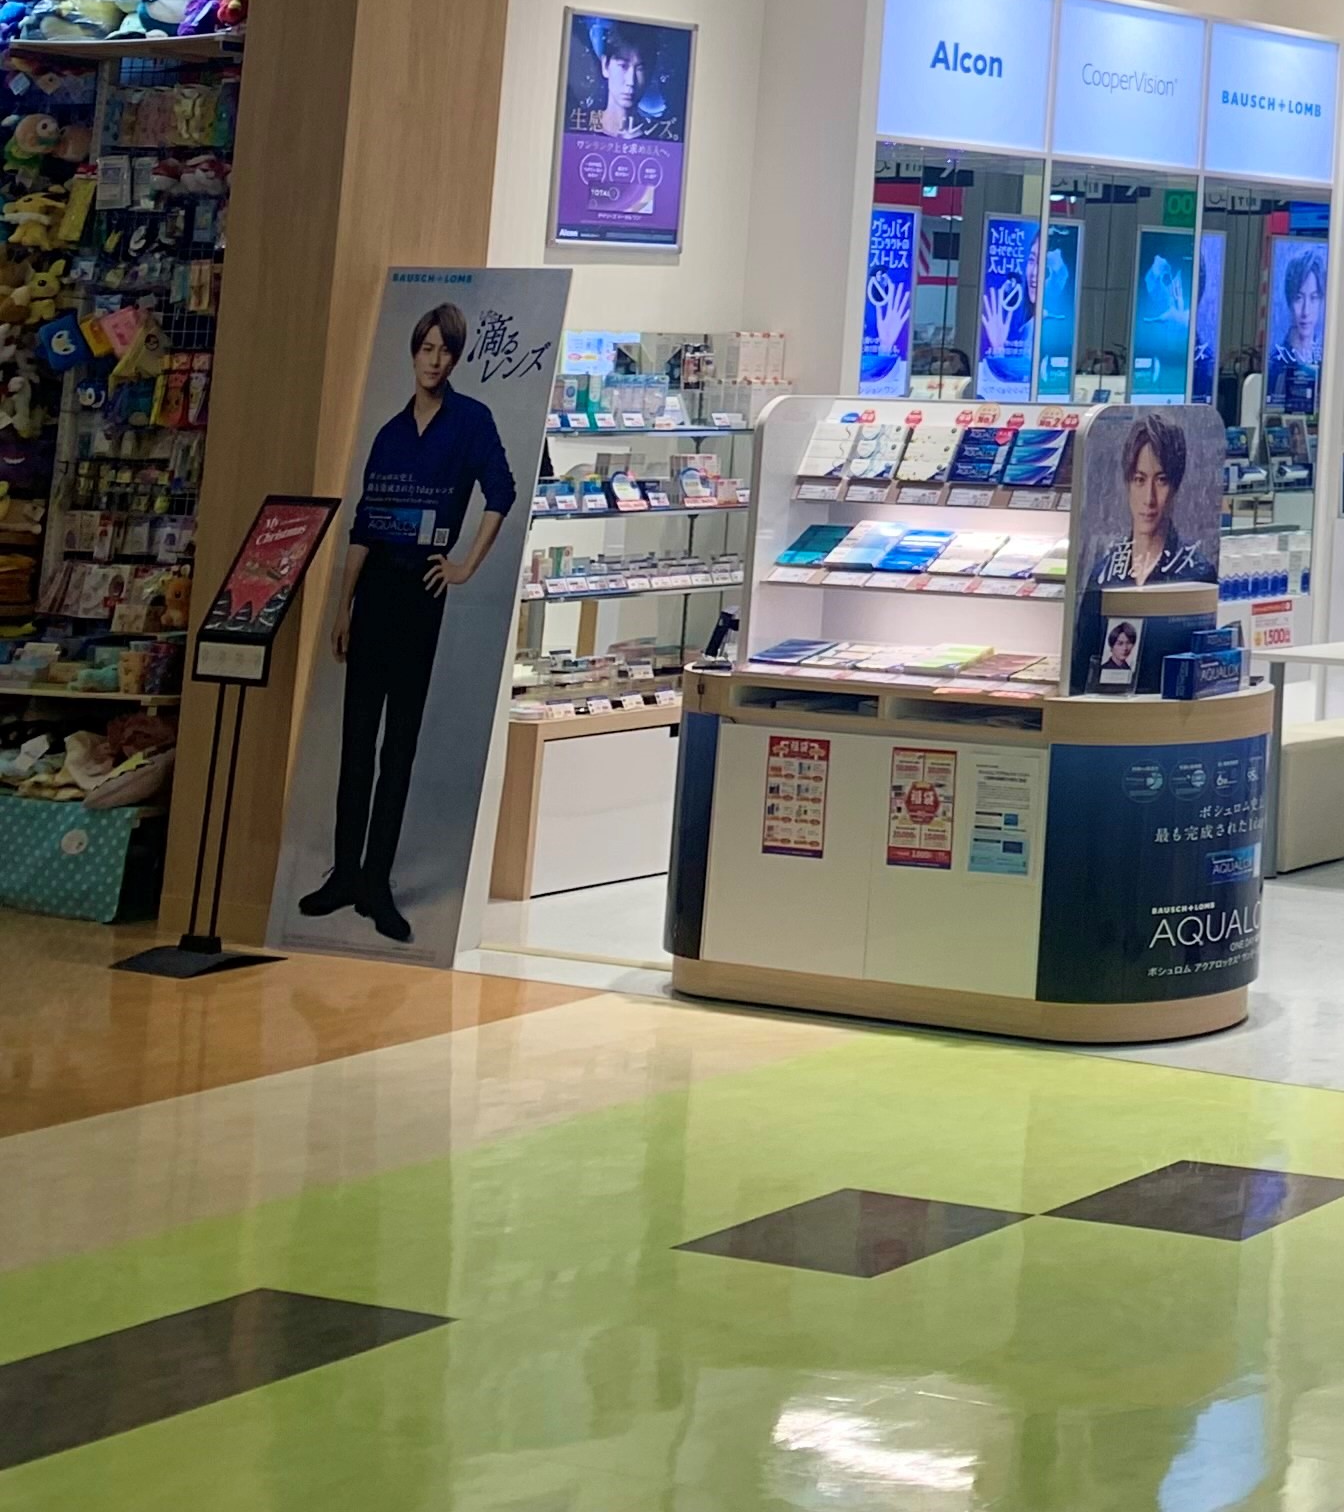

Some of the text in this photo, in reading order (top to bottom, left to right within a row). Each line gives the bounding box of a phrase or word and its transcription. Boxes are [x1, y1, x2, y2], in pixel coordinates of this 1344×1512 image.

[929, 39, 1004, 79] Alcon
[1081, 62, 1178, 98] CooperVision
[869, 249, 909, 268] ストレス
[1147, 963, 1192, 977] ボシュロム
